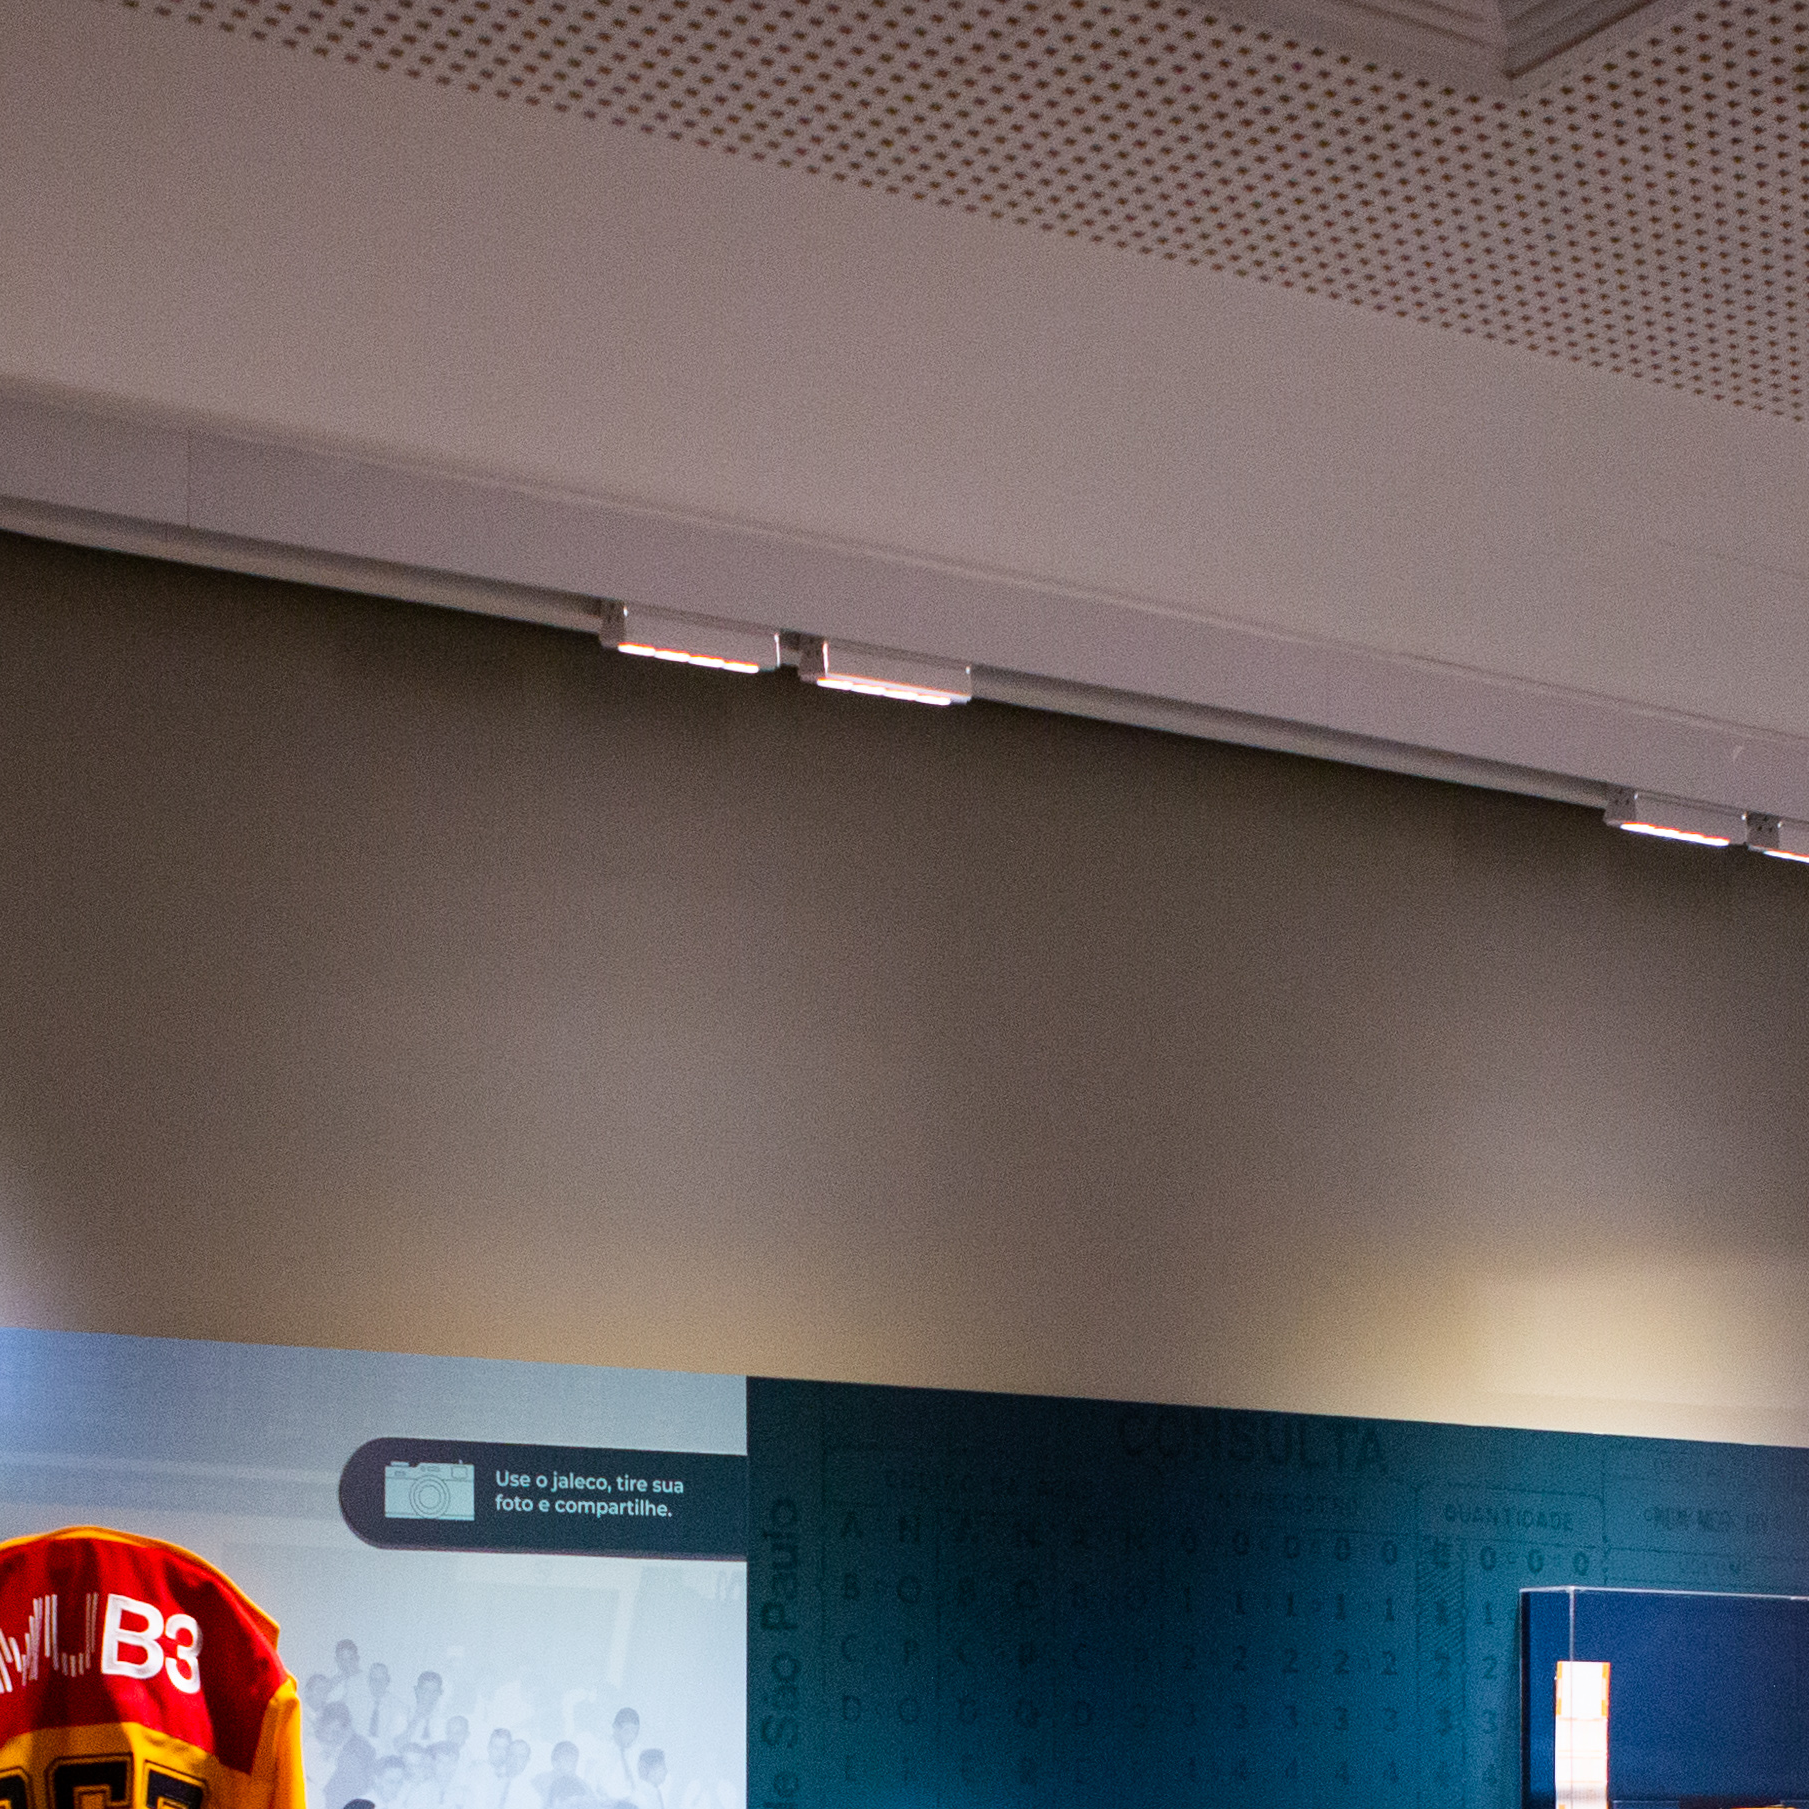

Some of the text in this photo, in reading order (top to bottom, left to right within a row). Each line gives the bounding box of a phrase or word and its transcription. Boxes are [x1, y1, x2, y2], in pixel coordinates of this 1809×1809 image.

[495, 1470, 684, 1494] Use o jaleco, tire sua
[495, 1494, 673, 1519] foto e compartilhe.
